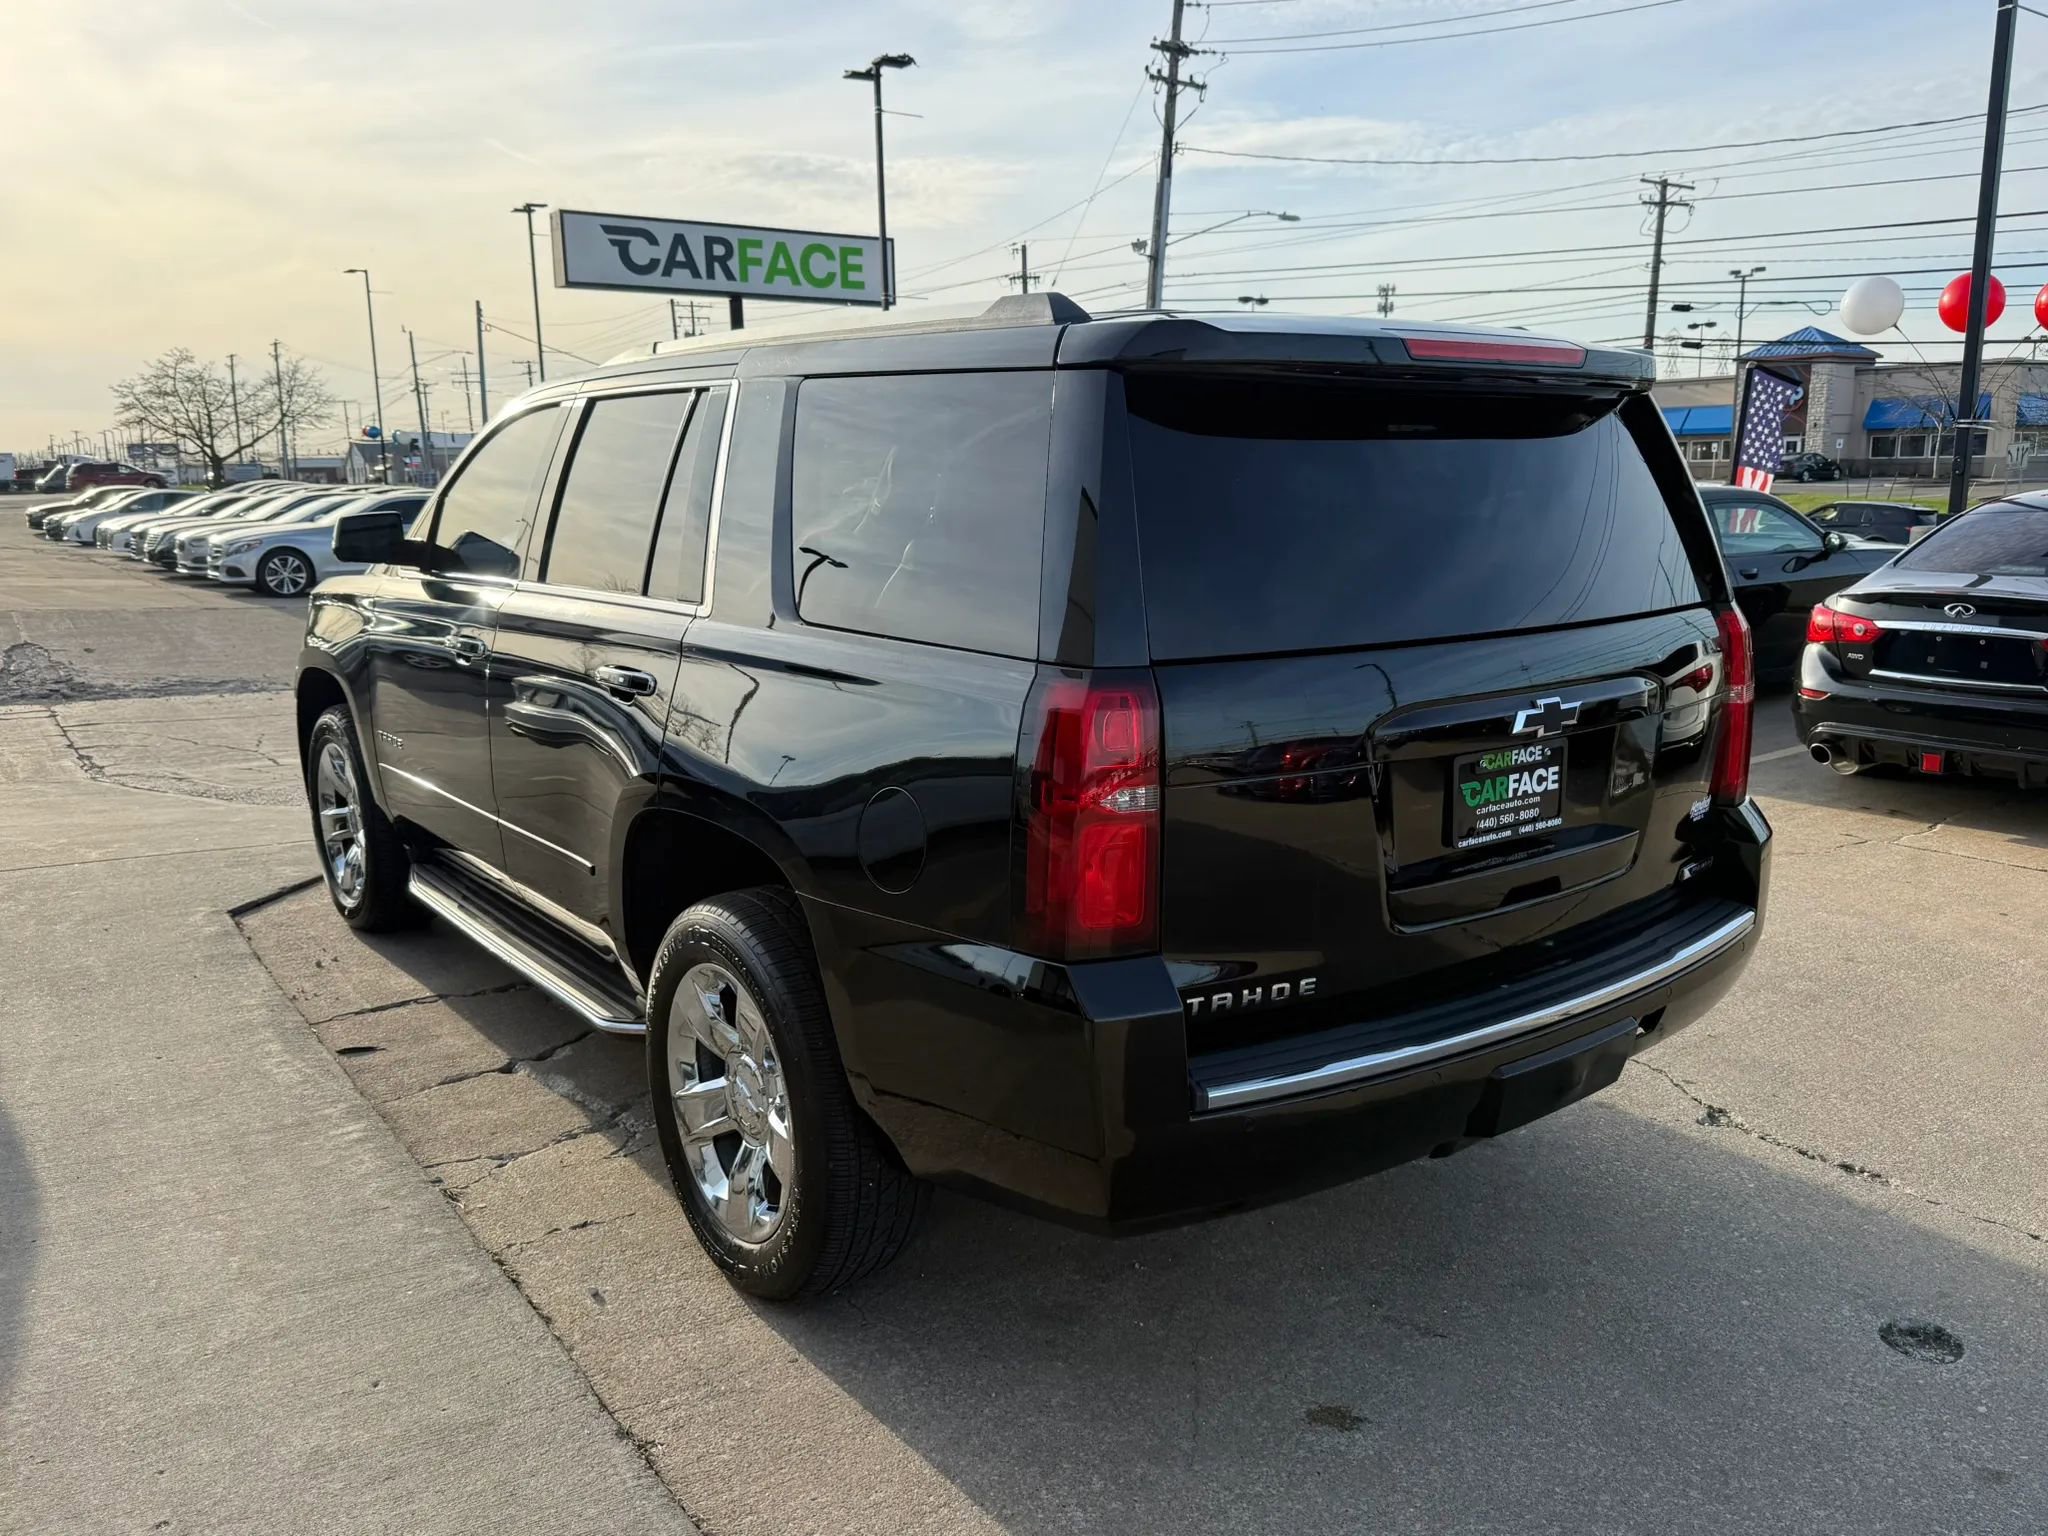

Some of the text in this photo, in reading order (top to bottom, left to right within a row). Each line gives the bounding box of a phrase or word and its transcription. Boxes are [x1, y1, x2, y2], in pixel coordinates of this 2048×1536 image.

[599, 223, 866, 290] CARFACE
[1483, 746, 1542, 770] CARFACE
[1460, 766, 1560, 807] CARFACE
[1476, 796, 1541, 815] carfaceauto.com
[1476, 816, 1497, 829] (440)
[1458, 830, 1512, 848] carfaceauto.com
[1186, 977, 1317, 1016] TAHOE
